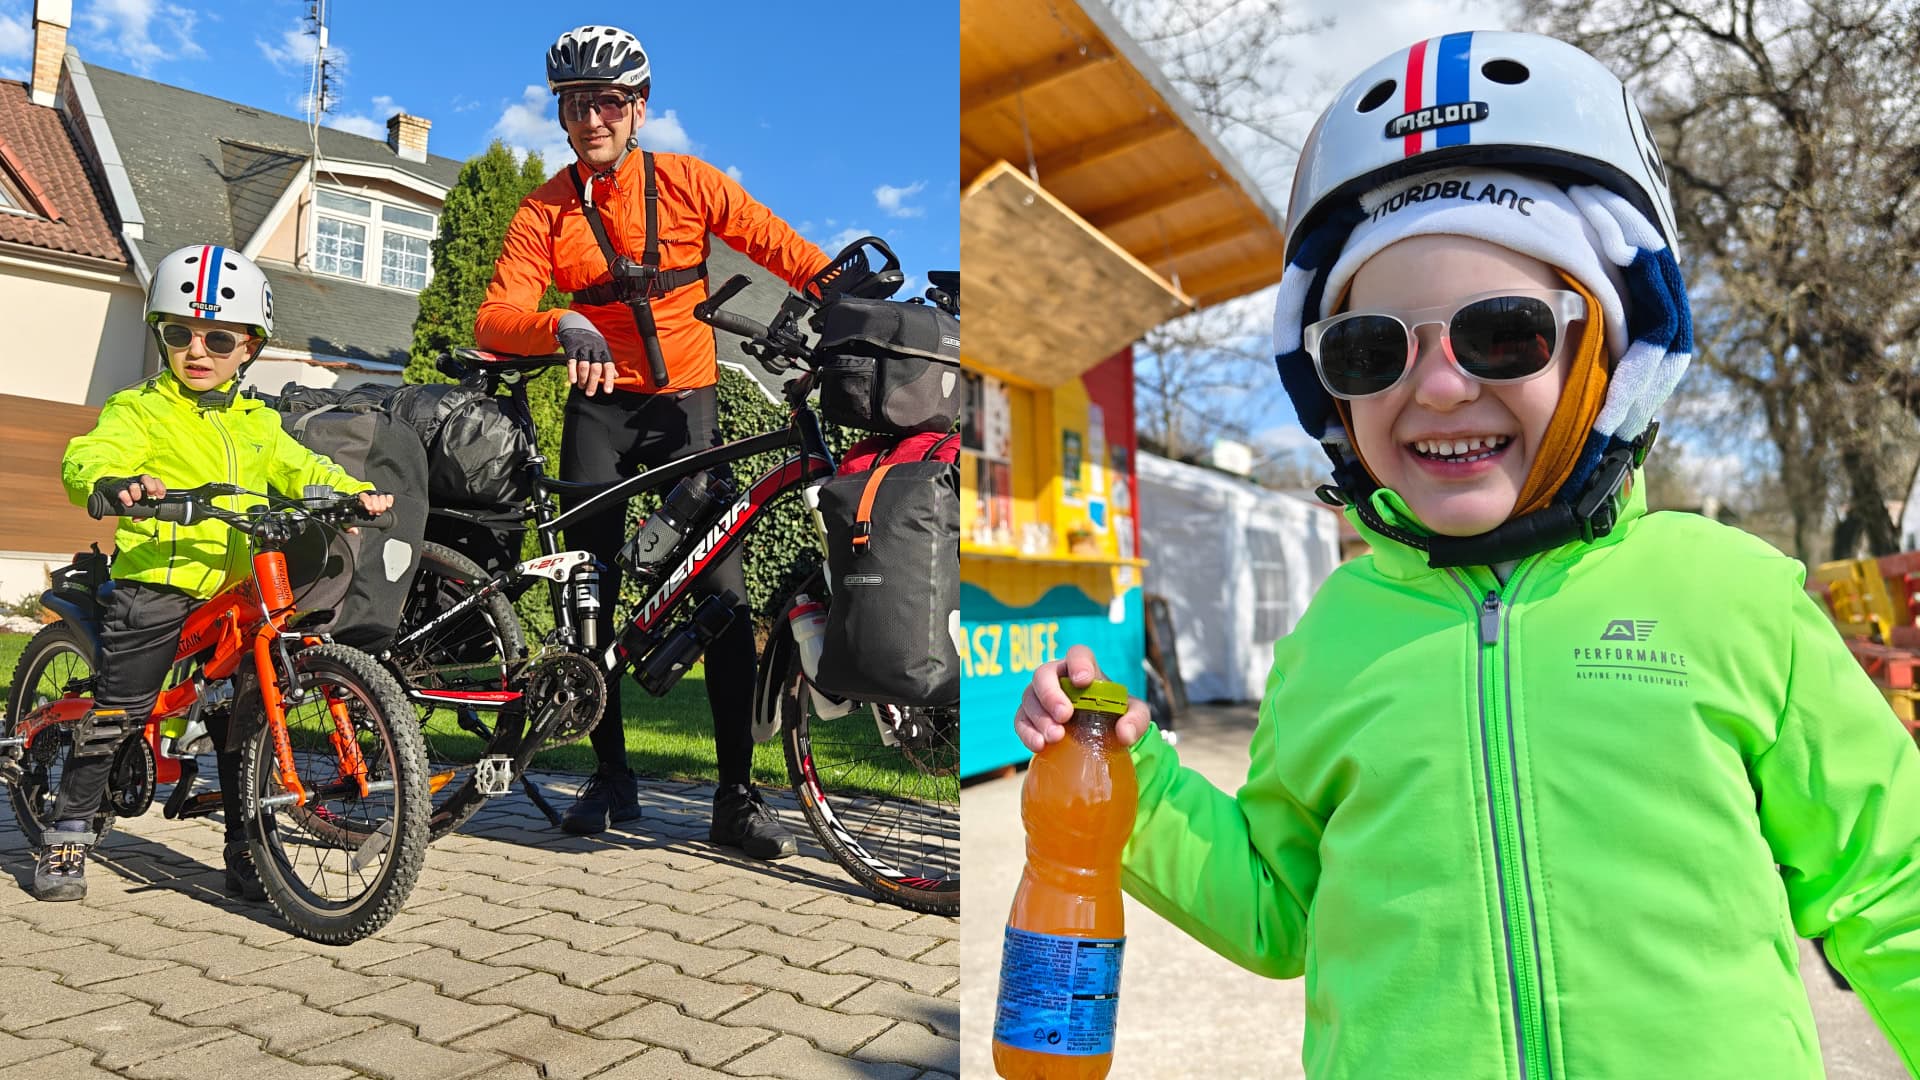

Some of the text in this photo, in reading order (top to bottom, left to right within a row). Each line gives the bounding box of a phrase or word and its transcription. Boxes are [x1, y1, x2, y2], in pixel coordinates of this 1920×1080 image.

[1372, 180, 1535, 223] NORDBLANC
[633, 490, 750, 624] MERIDA
[1574, 648, 1686, 667] PERFORMANCE
[1577, 671, 1610, 679] ALPINE
[1638, 675, 1688, 688] EQUIPMENT
[246, 739, 257, 820] SCHWALBE
